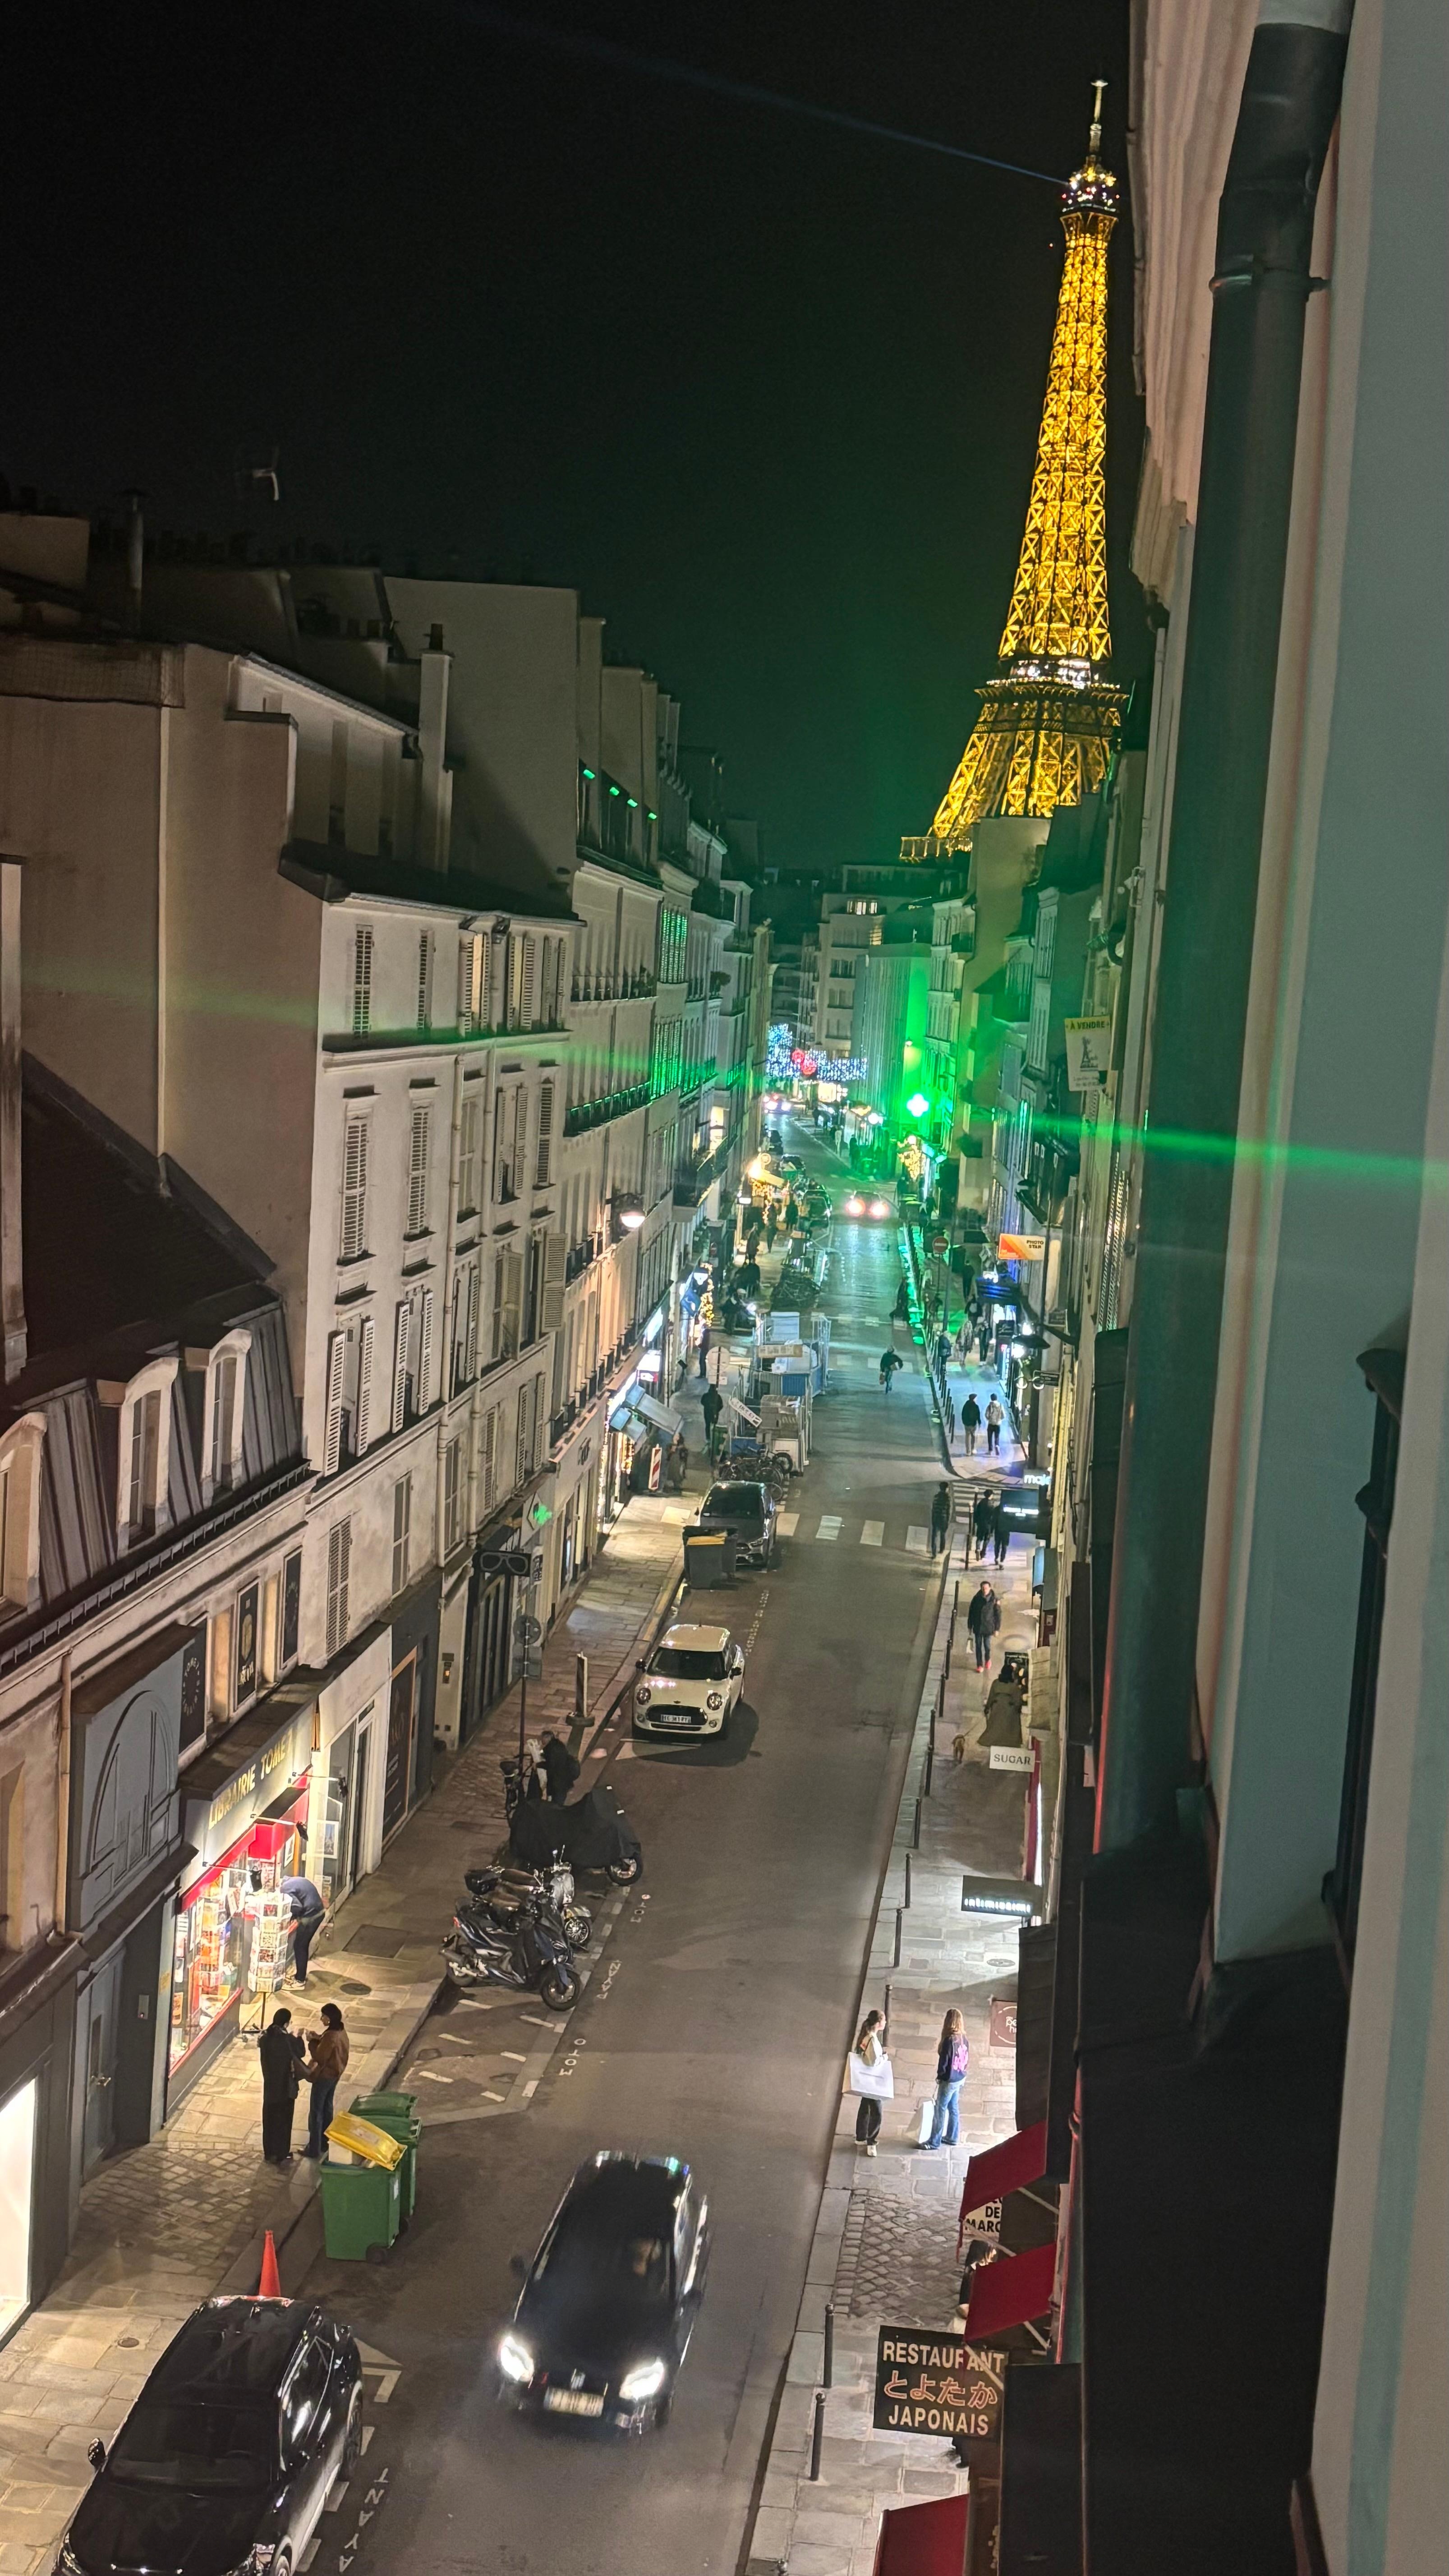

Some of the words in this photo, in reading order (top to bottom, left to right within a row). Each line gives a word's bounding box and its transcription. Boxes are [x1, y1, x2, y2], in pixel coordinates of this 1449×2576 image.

[1070, 1020, 1076, 1030] À
[1077, 1020, 1105, 1030] VENDRE
[994, 1753, 1031, 1765] SUGAR
[208, 1763, 256, 1831] LIBRAIRIE
[558, 2038, 587, 2076] MOTO
[985, 2205, 1001, 2219] DE
[883, 2341, 1005, 2374] RESTAURANT
[884, 2370, 998, 2409] とよたか
[888, 2405, 989, 2436] JAPONAIS
